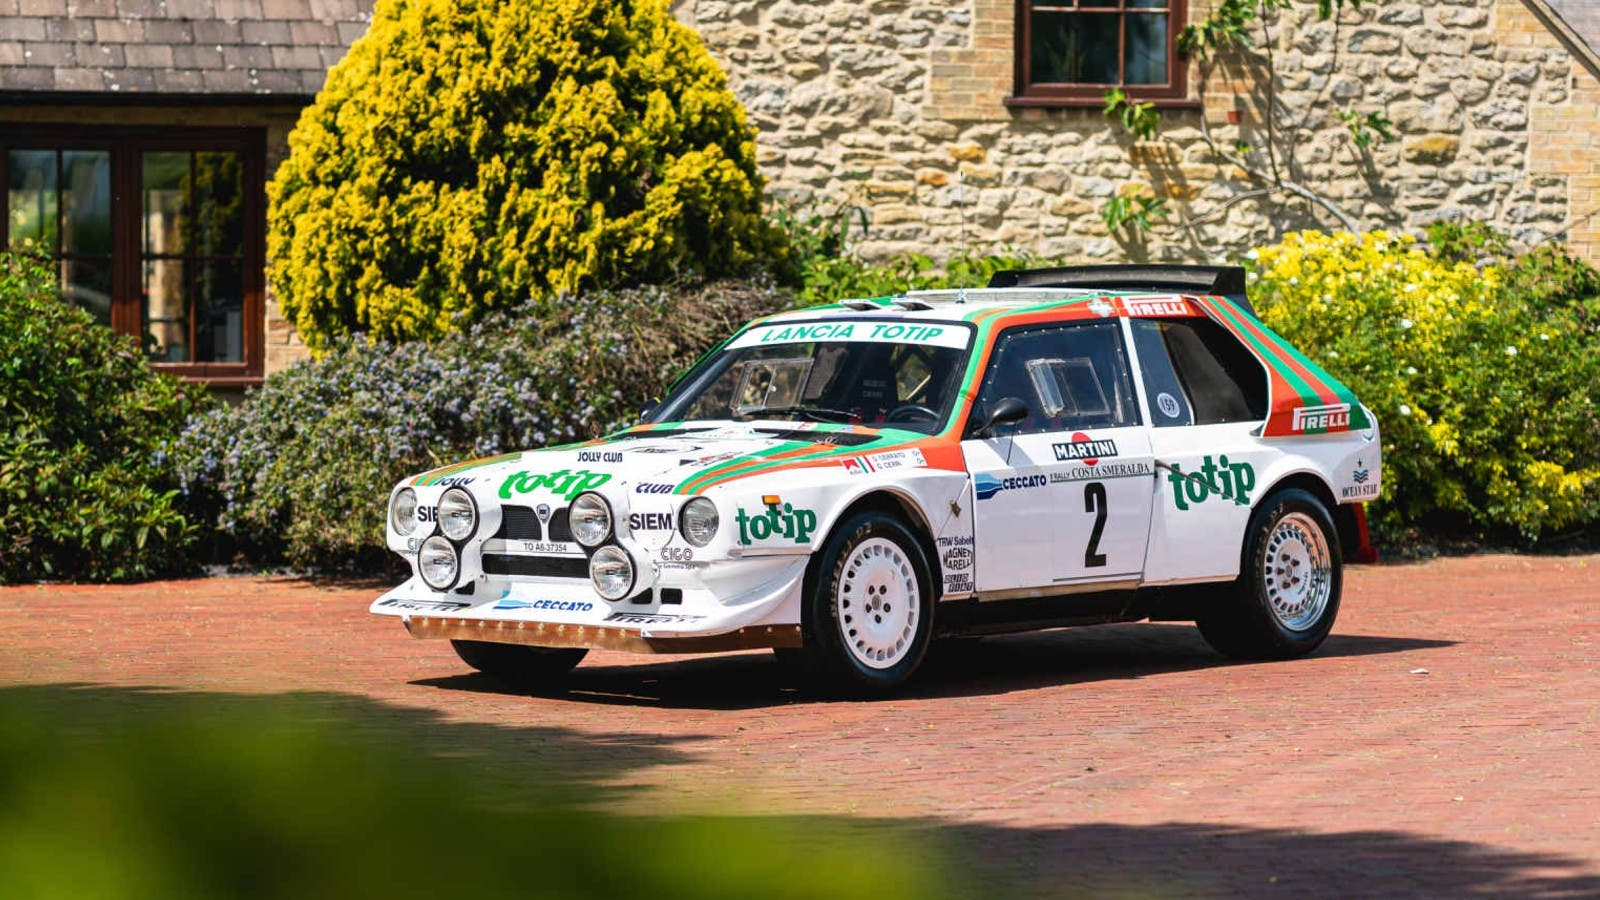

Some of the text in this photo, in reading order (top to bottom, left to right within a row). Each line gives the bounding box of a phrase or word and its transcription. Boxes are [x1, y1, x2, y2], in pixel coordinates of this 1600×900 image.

[1121, 294, 1187, 316] PIRELLI
[761, 324, 943, 343] LANCIA TOTIP
[1292, 403, 1351, 431] PIRELLI
[577, 452, 623, 463] JOLLY CLUB
[1054, 441, 1116, 459] MARTINI
[1072, 466, 1101, 479] COSTA
[1102, 463, 1150, 476] SMERALDA
[498, 469, 612, 502] totip
[636, 483, 675, 495] CLUB
[1002, 474, 1047, 490] CECCATO
[1168, 454, 1256, 511] totip
[417, 506, 440, 522] SIE
[630, 513, 673, 531] SIEM
[735, 502, 817, 546] totip
[1084, 482, 1108, 569] 2
[532, 599, 594, 612] CECCATO
